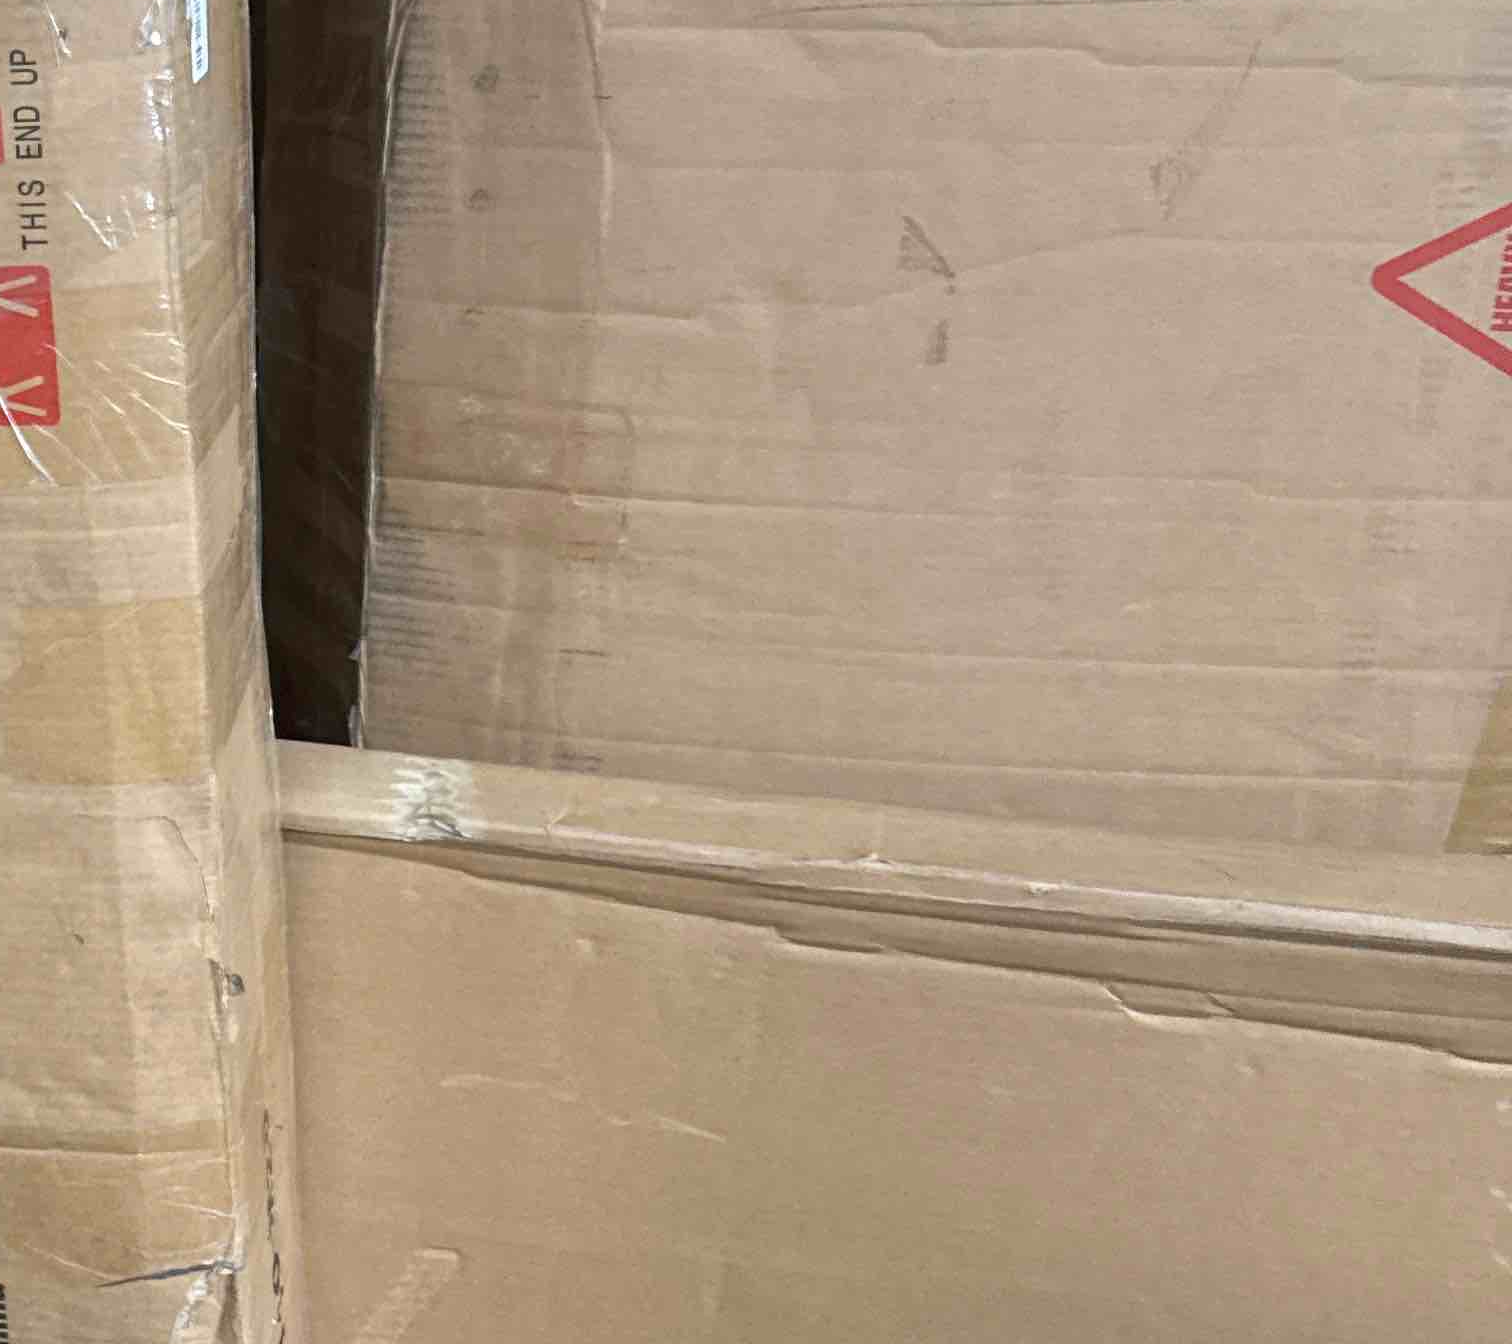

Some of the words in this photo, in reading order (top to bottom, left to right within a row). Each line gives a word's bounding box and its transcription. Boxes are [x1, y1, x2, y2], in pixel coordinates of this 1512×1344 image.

[9, 49, 38, 86] UP
[13, 105, 43, 160] END
[17, 179, 48, 251] THIS
[1489, 232, 1512, 332] HEA
